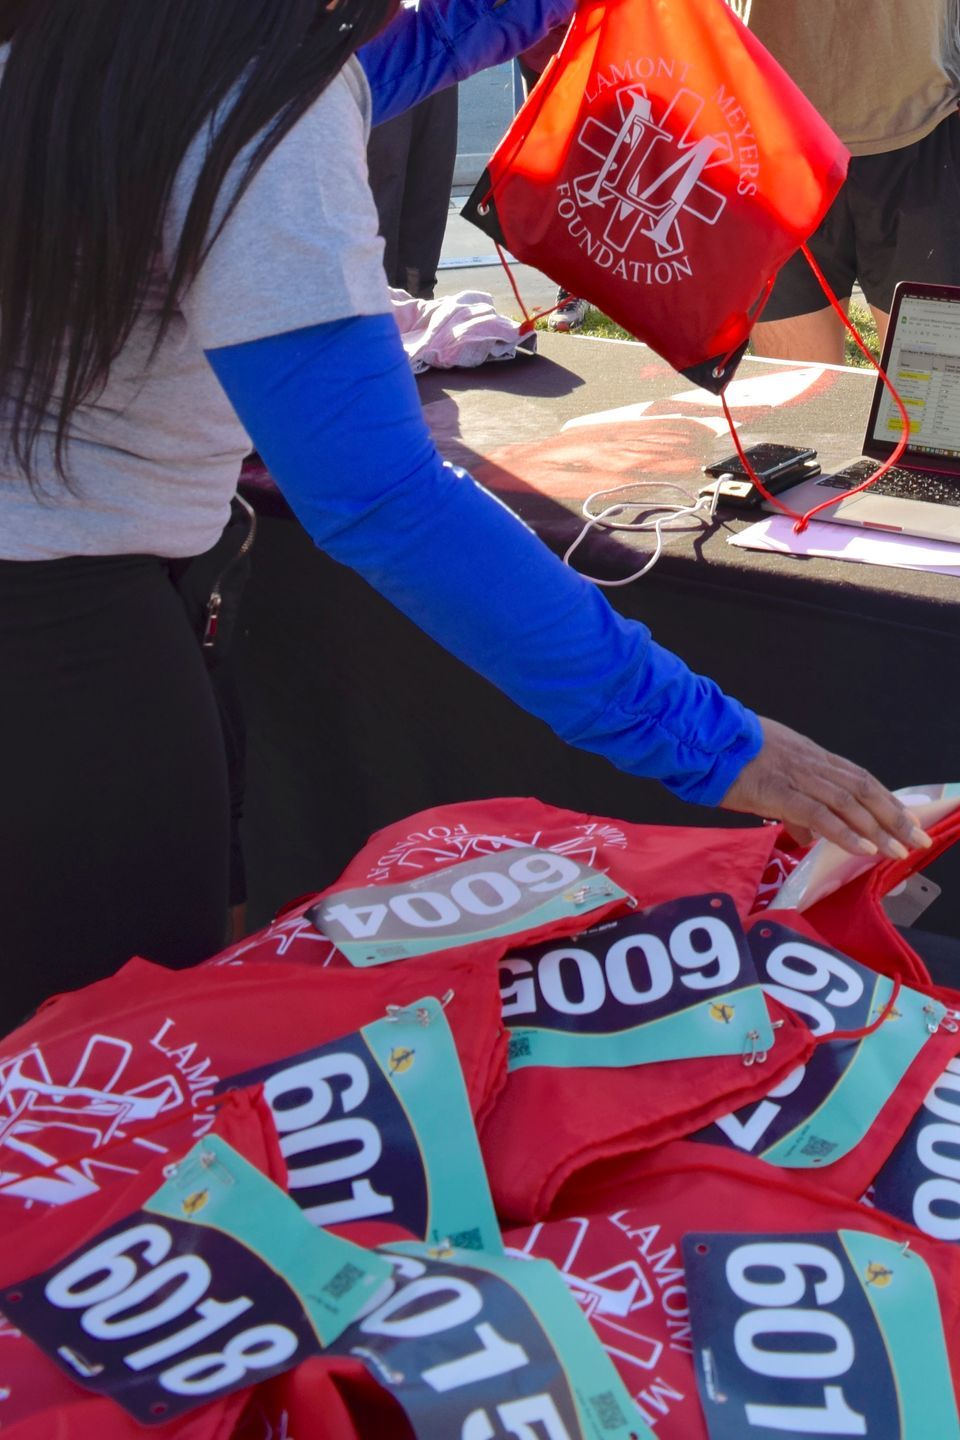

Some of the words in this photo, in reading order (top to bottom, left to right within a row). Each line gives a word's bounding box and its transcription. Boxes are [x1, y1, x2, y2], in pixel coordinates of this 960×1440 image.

[585, 56, 694, 104] LAMONT
[710, 85, 761, 198] MEYERS
[556, 182, 694, 286] FOUNDATION
[323, 853, 581, 939] 6004
[497, 916, 740, 1019] 6005
[45, 1223, 298, 1395] 6018
[726, 1242, 867, 1435] 601
